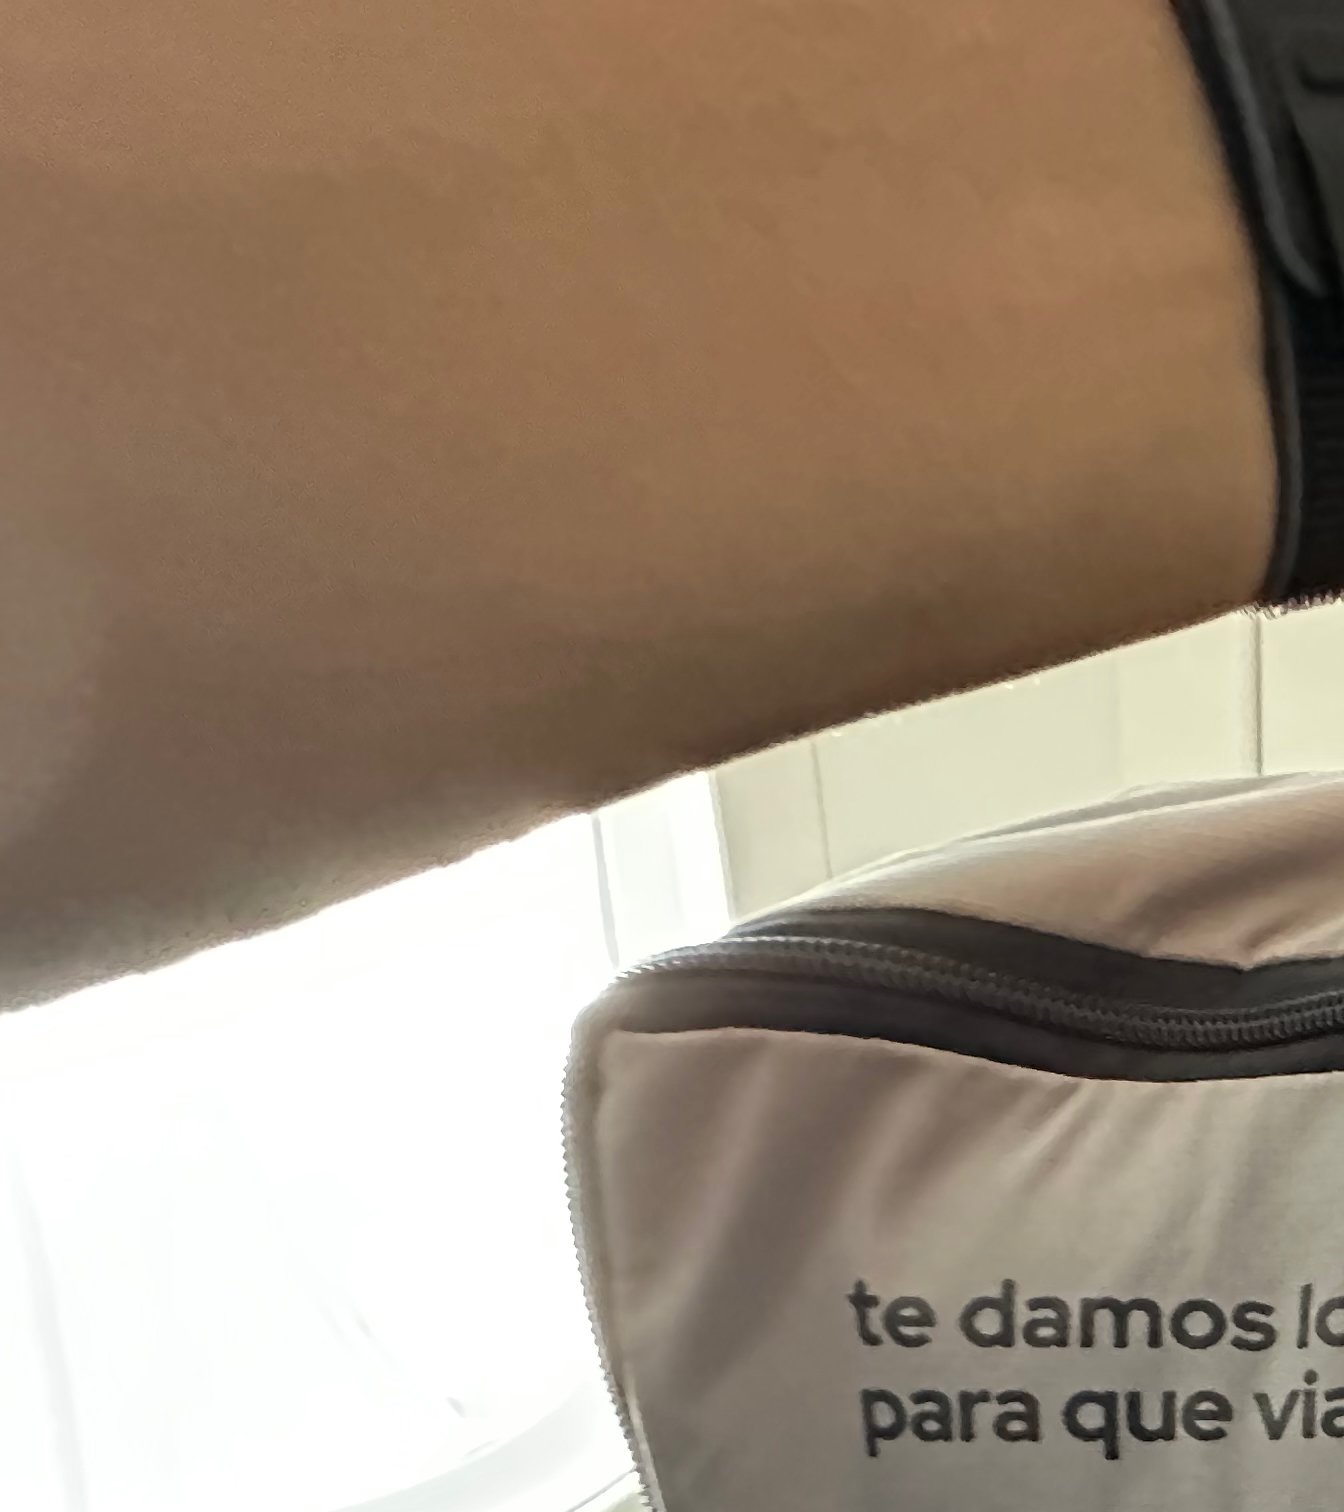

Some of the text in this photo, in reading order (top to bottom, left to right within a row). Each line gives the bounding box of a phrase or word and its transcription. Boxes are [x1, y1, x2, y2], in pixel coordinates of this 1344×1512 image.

[850, 1281, 936, 1350] te
[959, 1279, 1278, 1352] damos
[861, 1378, 1040, 1458] para
[1062, 1378, 1233, 1461] que
